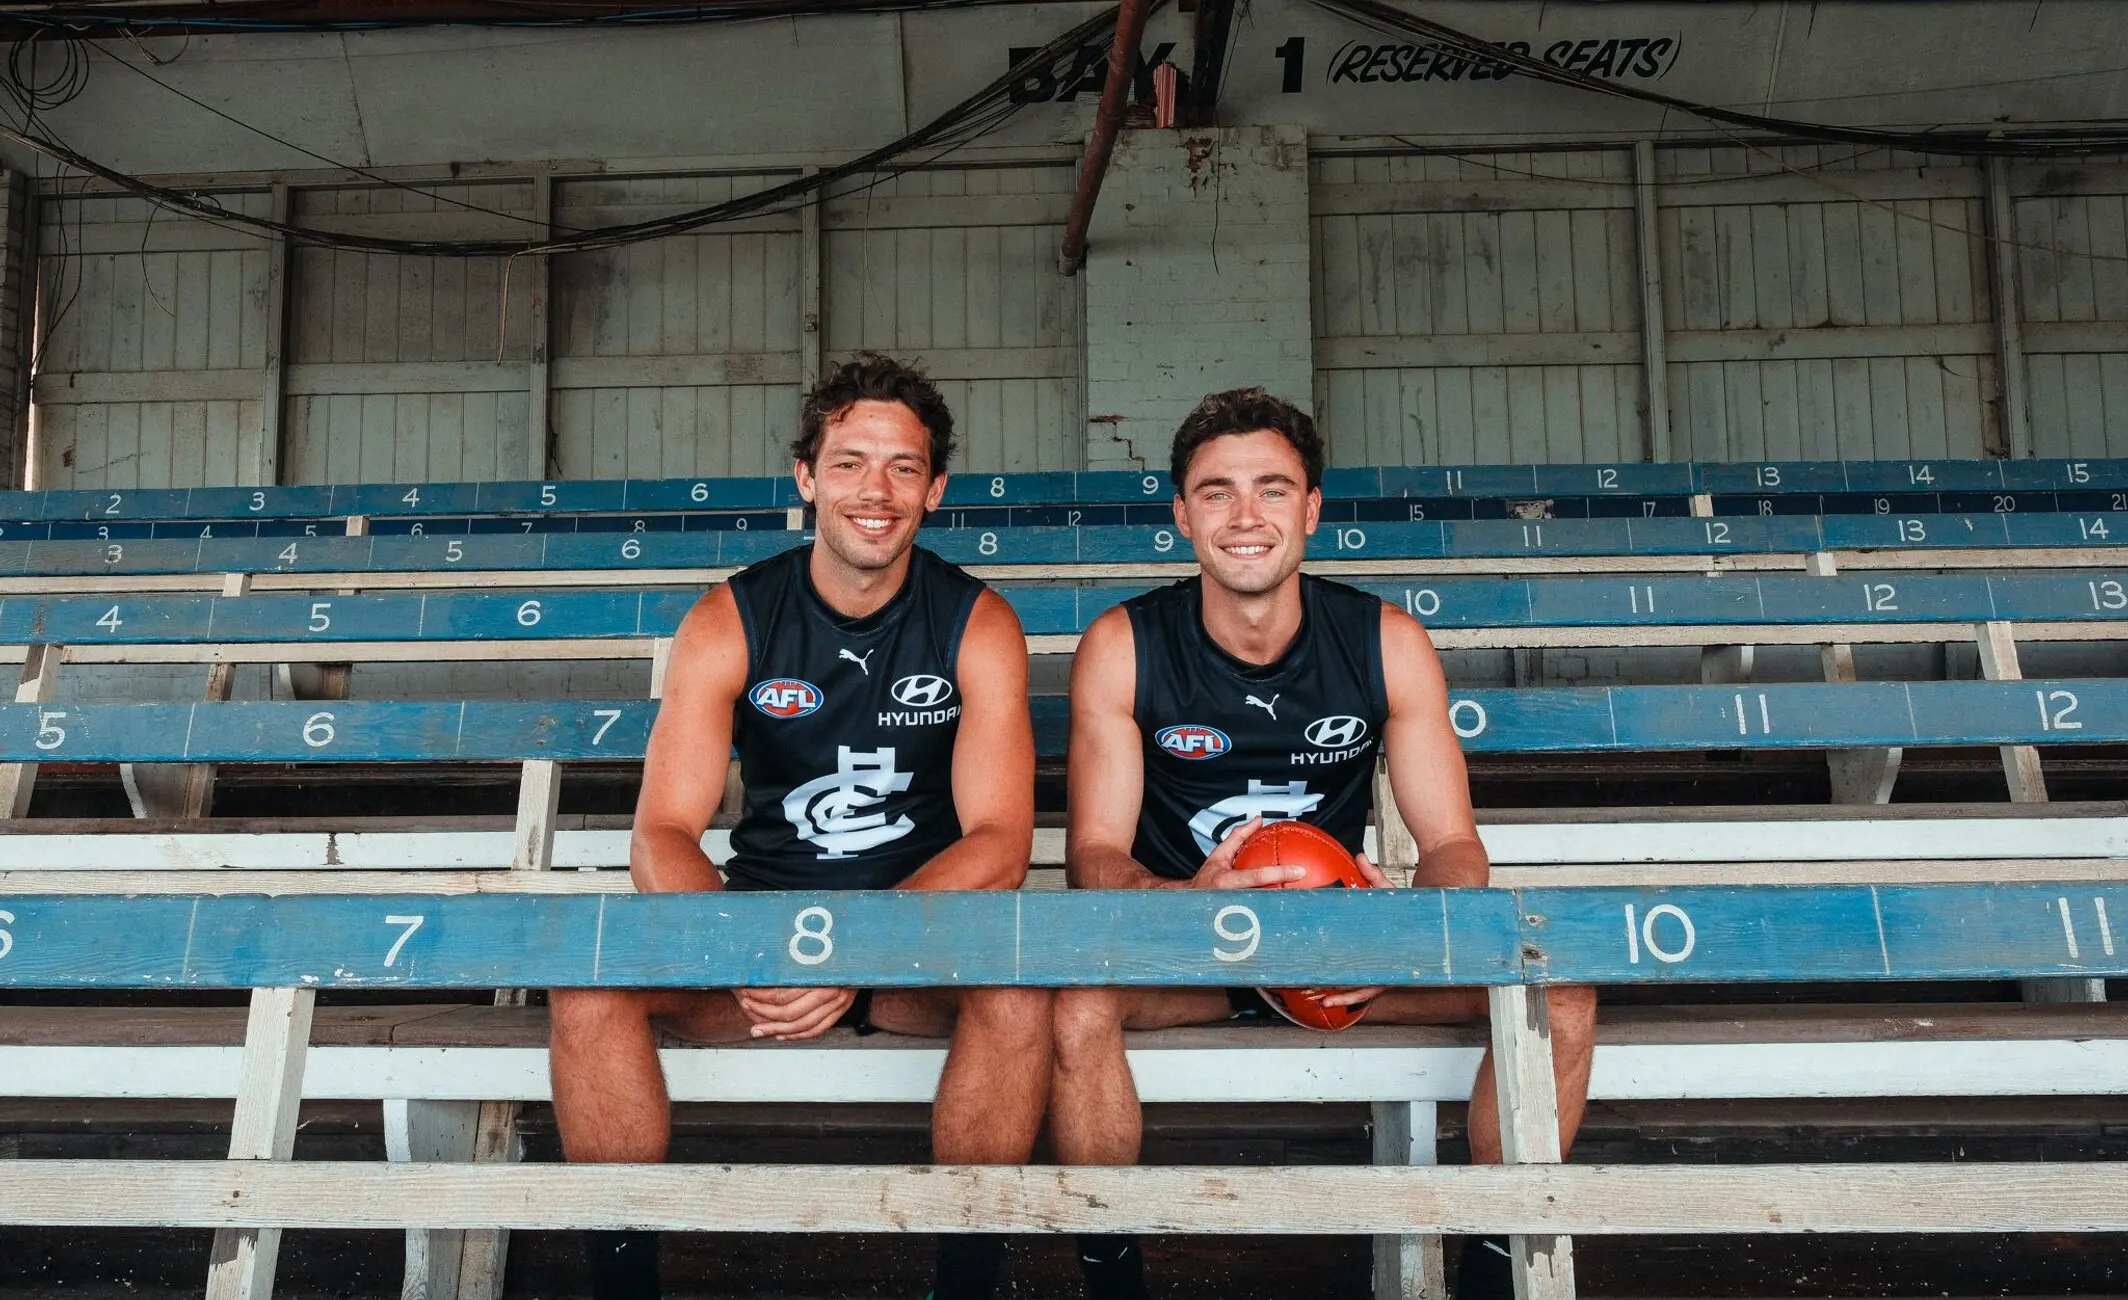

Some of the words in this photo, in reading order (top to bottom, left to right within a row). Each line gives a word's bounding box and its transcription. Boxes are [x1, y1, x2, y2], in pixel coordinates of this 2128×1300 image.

[1275, 36, 1305, 93] 1
[1446, 470, 1462, 490] 11
[1598, 469, 1618, 488] 12
[1756, 467, 1780, 487] 13
[1909, 465, 1934, 485] 14
[2067, 463, 2090, 483] 15
[541, 485, 557, 505] 5
[691, 483, 708, 502] 6
[990, 477, 1005, 498] 8
[1142, 476, 1159, 495] 9
[105, 495, 121, 514] 2
[249, 492, 265, 511] 3
[402, 488, 420, 508] 4
[1759, 500, 1773, 516] 18
[1874, 498, 1890, 515] 19
[1993, 495, 2015, 512] 20
[1068, 511, 1081, 527] 12
[1410, 504, 1424, 521] 15
[1643, 502, 1656, 518] 17
[736, 518, 748, 532] 9
[952, 512, 964, 530] 11
[1898, 520, 1925, 541] 13
[2079, 518, 2109, 539] 14
[1154, 530, 1174, 551] 9
[1338, 529, 1366, 549] 10
[1523, 525, 1541, 547] 11
[1706, 522, 1731, 543] 12
[104, 544, 122, 564] 3
[278, 543, 298, 565] 4
[446, 541, 462, 562] 5
[622, 539, 640, 560] 6
[978, 532, 998, 555] 8
[1405, 589, 1441, 616] 10
[1629, 586, 1655, 613] 11
[1863, 584, 1898, 611] 12
[2088, 581, 2127, 610] 13
[96, 605, 122, 633] 4
[309, 603, 331, 632] 5
[516, 600, 542, 626] 6
[756, 688, 816, 708] AFL
[1449, 700, 1486, 738] 0
[1735, 694, 1770, 734] 11
[2037, 690, 2082, 731] 12
[36, 712, 67, 750] 5
[302, 712, 335, 747] 6
[592, 709, 621, 746] 7
[1160, 734, 1224, 753] AFL
[1291, 736, 1374, 765] HYUNDA
[788, 906, 833, 965] 8
[1213, 905, 1260, 962] 9
[1625, 904, 1695, 963] 10
[2059, 897, 2115, 960] 11
[383, 915, 424, 967] 7
